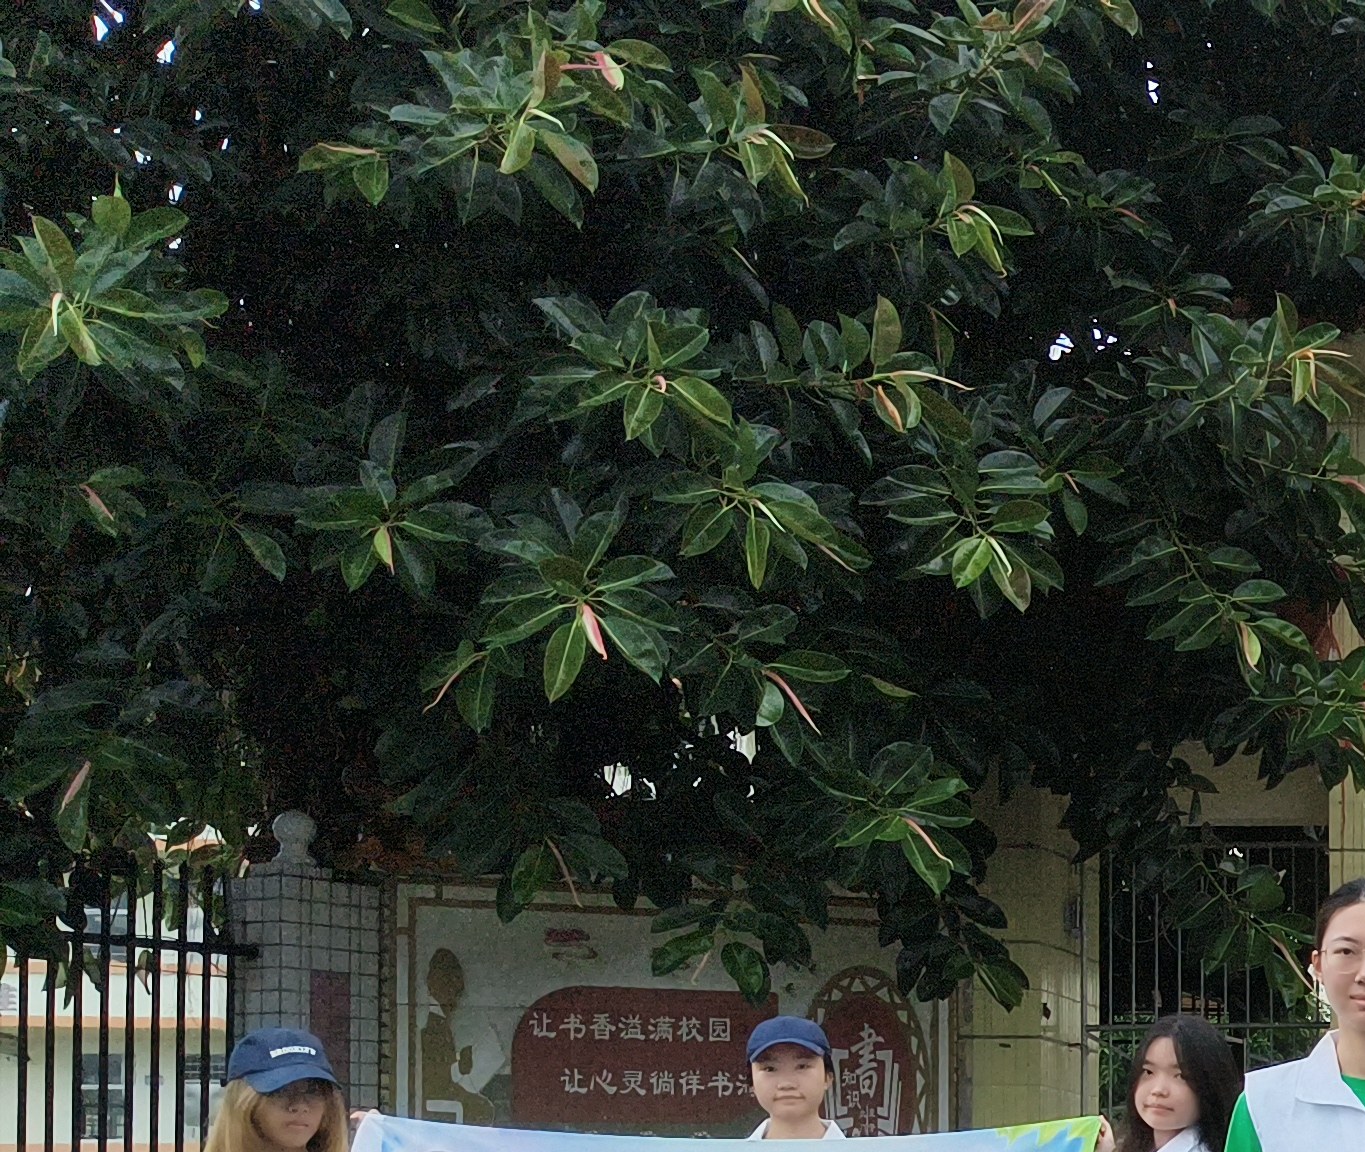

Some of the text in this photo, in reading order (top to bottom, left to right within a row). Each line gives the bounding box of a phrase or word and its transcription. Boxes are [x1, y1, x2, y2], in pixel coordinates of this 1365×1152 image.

[529, 1011, 731, 1042] 让书香溢满校园
